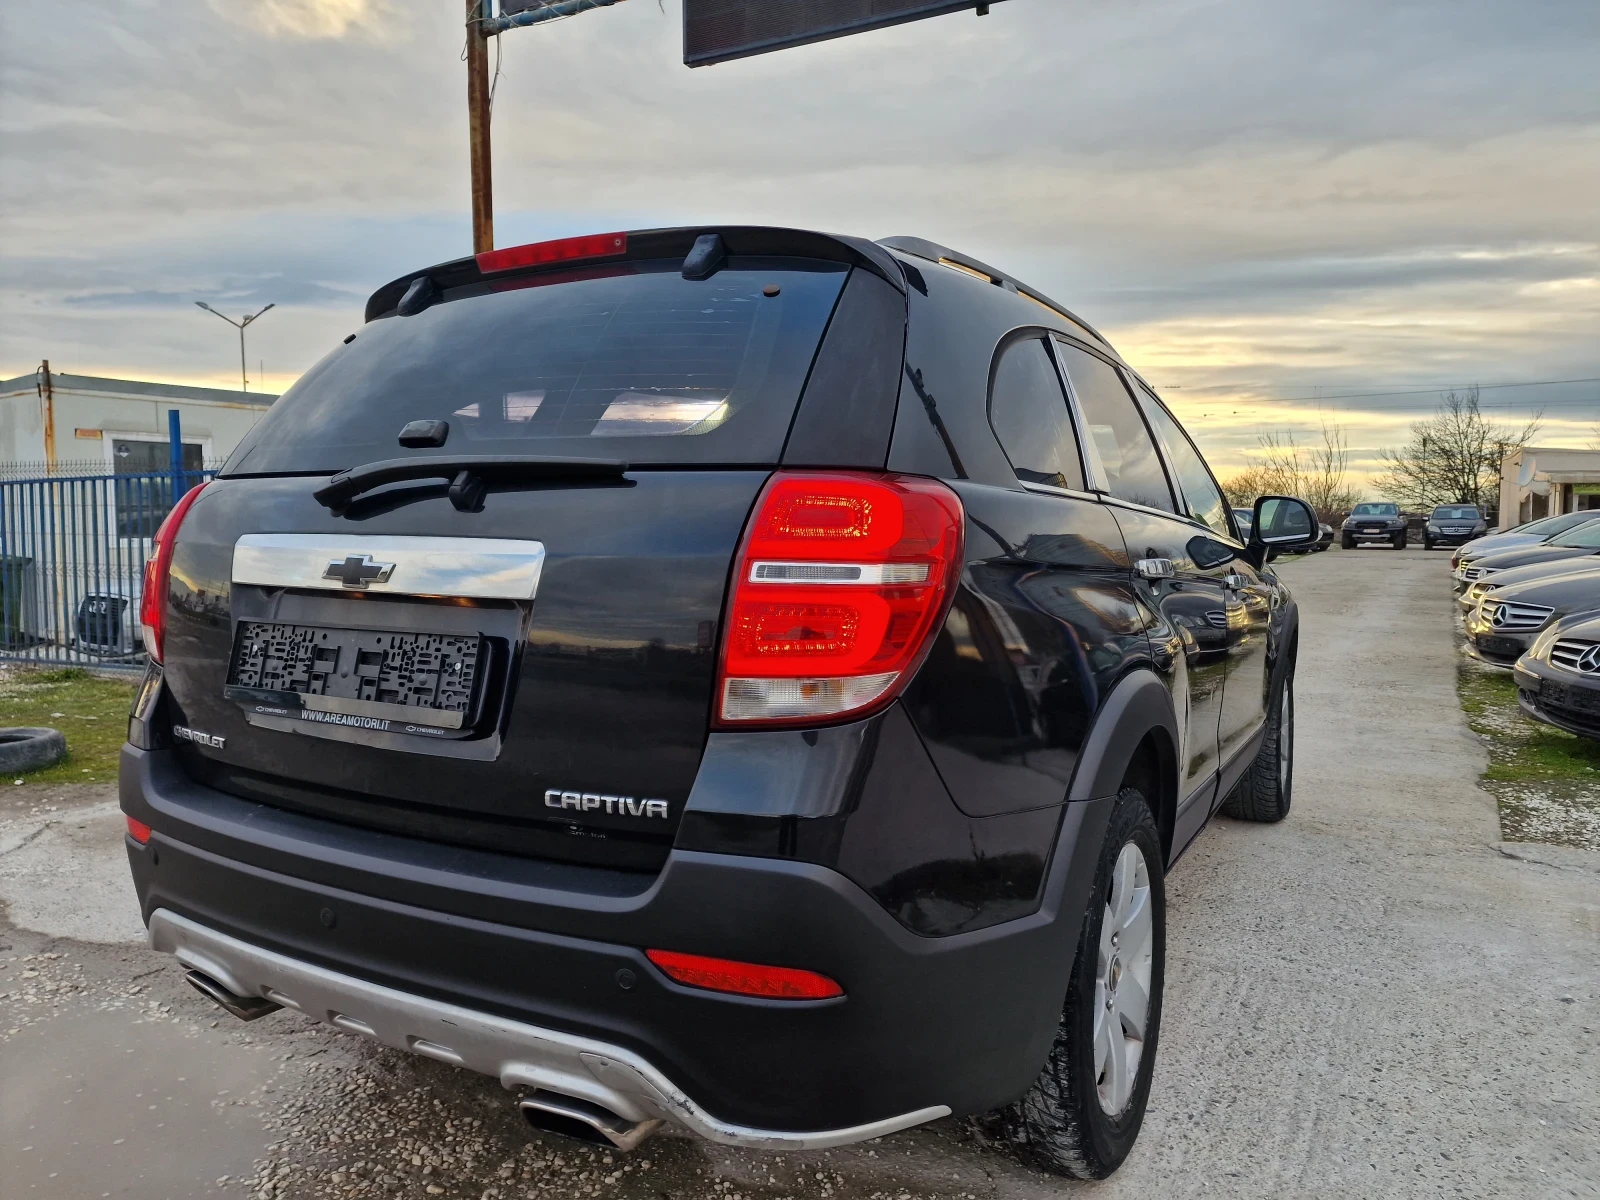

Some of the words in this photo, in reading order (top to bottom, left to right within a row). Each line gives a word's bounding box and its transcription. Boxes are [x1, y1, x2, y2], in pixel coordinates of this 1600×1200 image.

[301, 709, 391, 731] WWW.AREAMOTORI.IT
[173, 724, 226, 750] CHEVROLET
[544, 790, 668, 819] CAPTIVA
